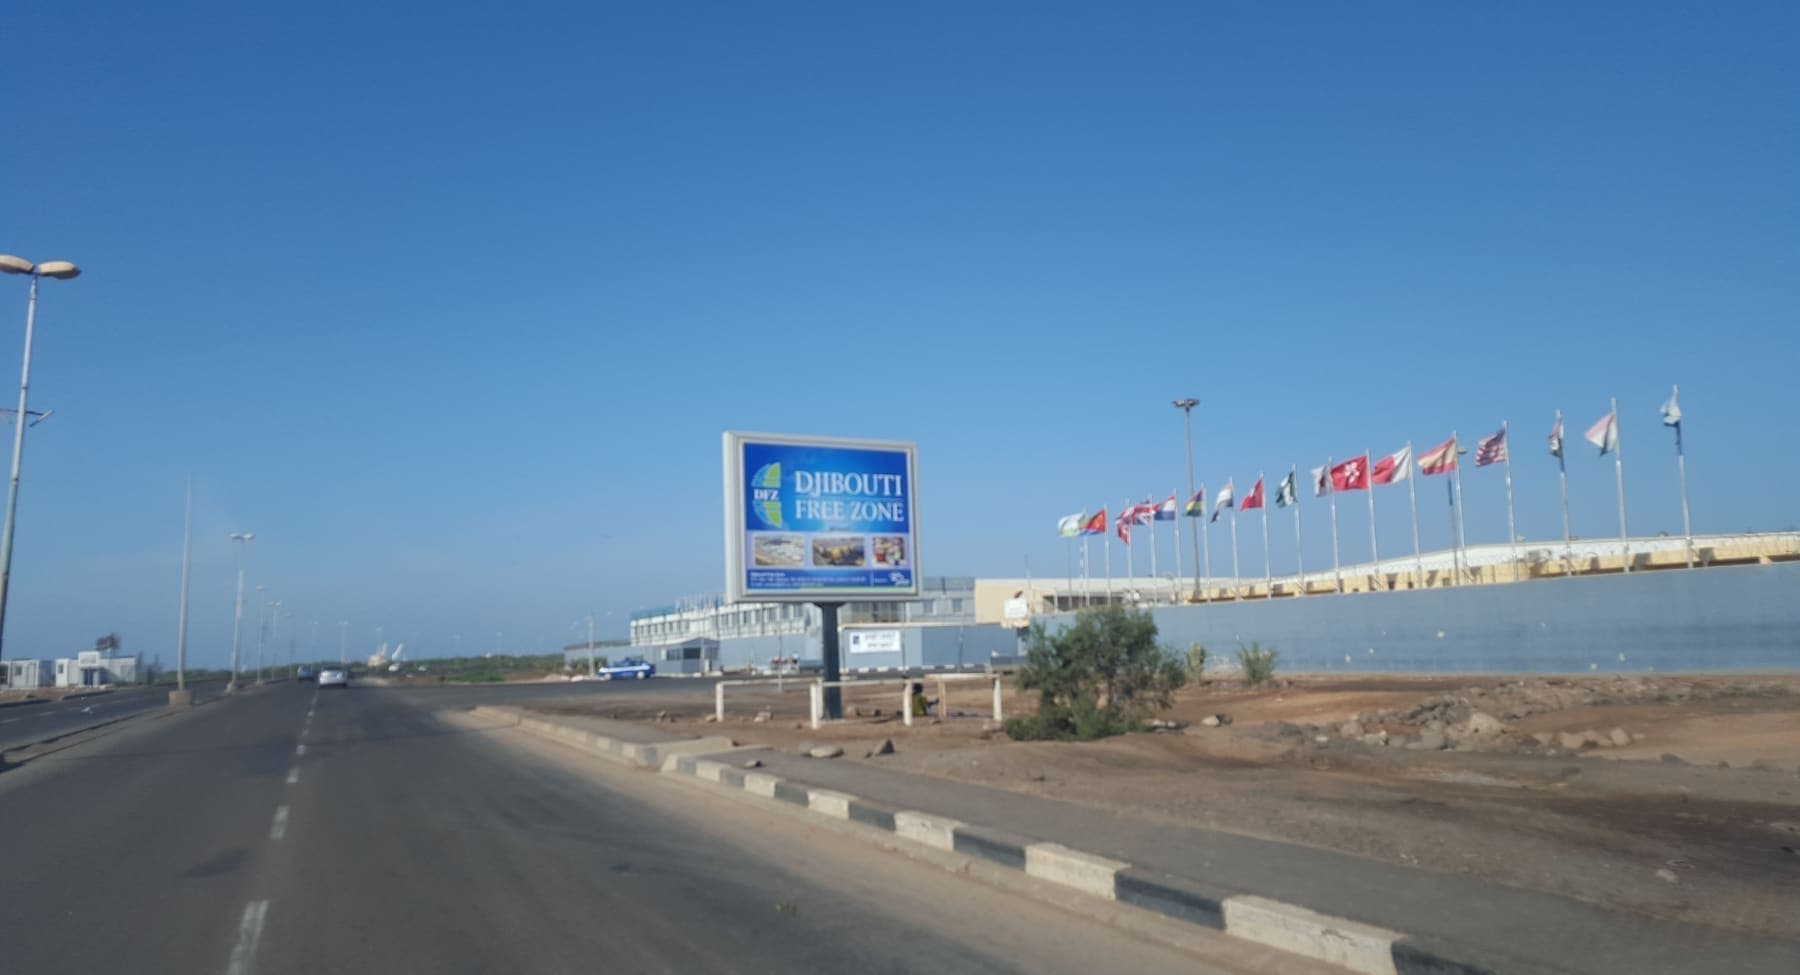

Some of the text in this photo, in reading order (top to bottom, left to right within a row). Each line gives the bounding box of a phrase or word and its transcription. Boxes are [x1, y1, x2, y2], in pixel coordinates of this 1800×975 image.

[754, 489, 779, 500] DFZ
[795, 470, 902, 497] DJIBOUTI
[795, 500, 904, 522] FREE ZONE
